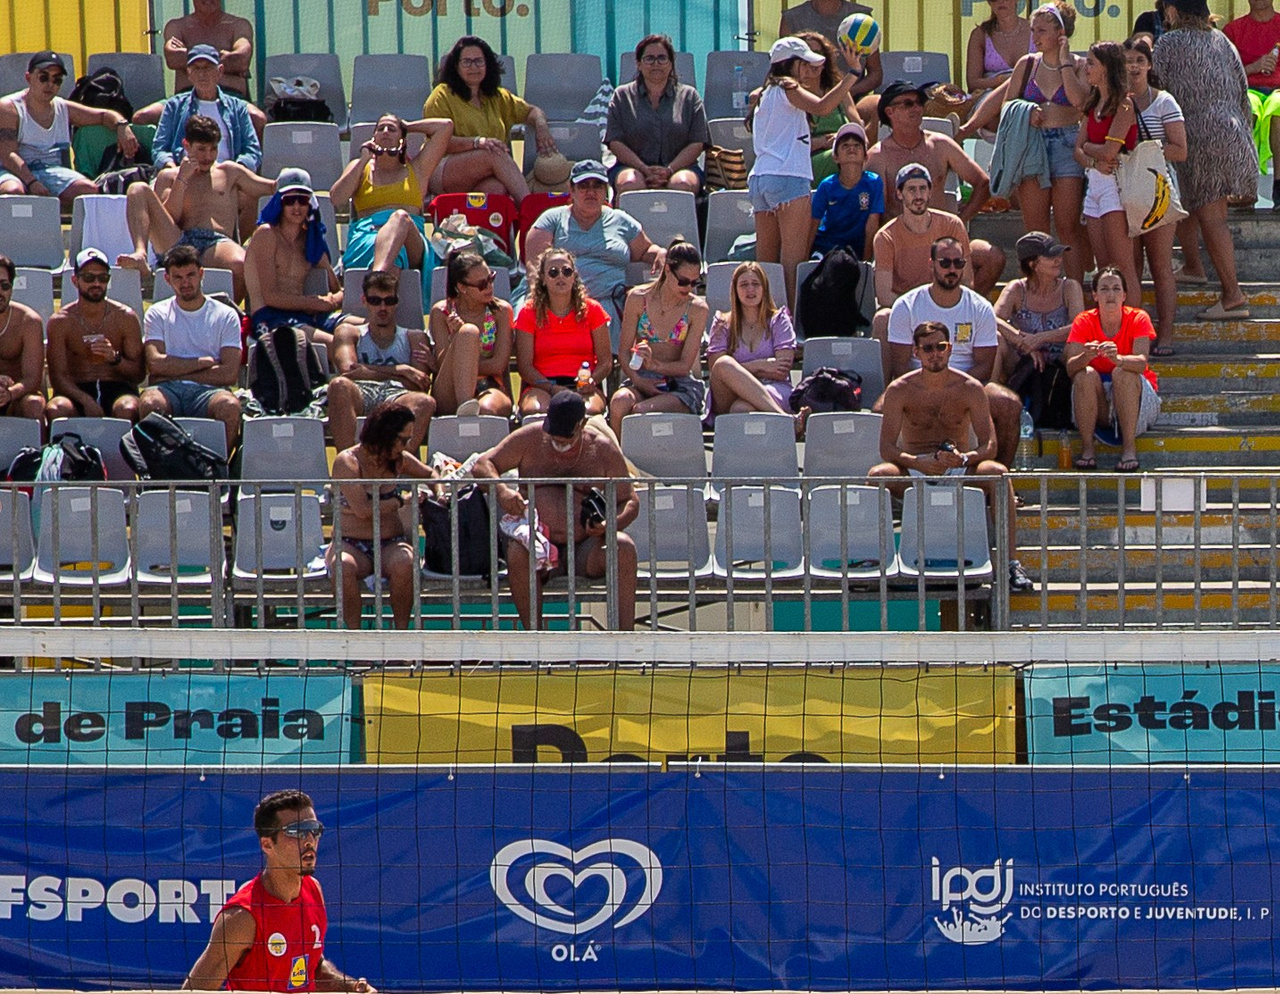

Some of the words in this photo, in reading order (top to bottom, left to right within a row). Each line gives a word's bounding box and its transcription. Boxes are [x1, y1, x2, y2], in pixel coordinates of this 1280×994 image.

[14, 701, 106, 744] de
[125, 697, 325, 741] Praia
[1019, 883, 1095, 897] INSTITUTO
[1100, 881, 1189, 898] PORTUGUÊS
[1020, 906, 1041, 919] DO
[1047, 906, 1130, 920] DESPORTO
[1134, 907, 1142, 919] E
[1146, 907, 1243, 922] JUVENTUDE,
